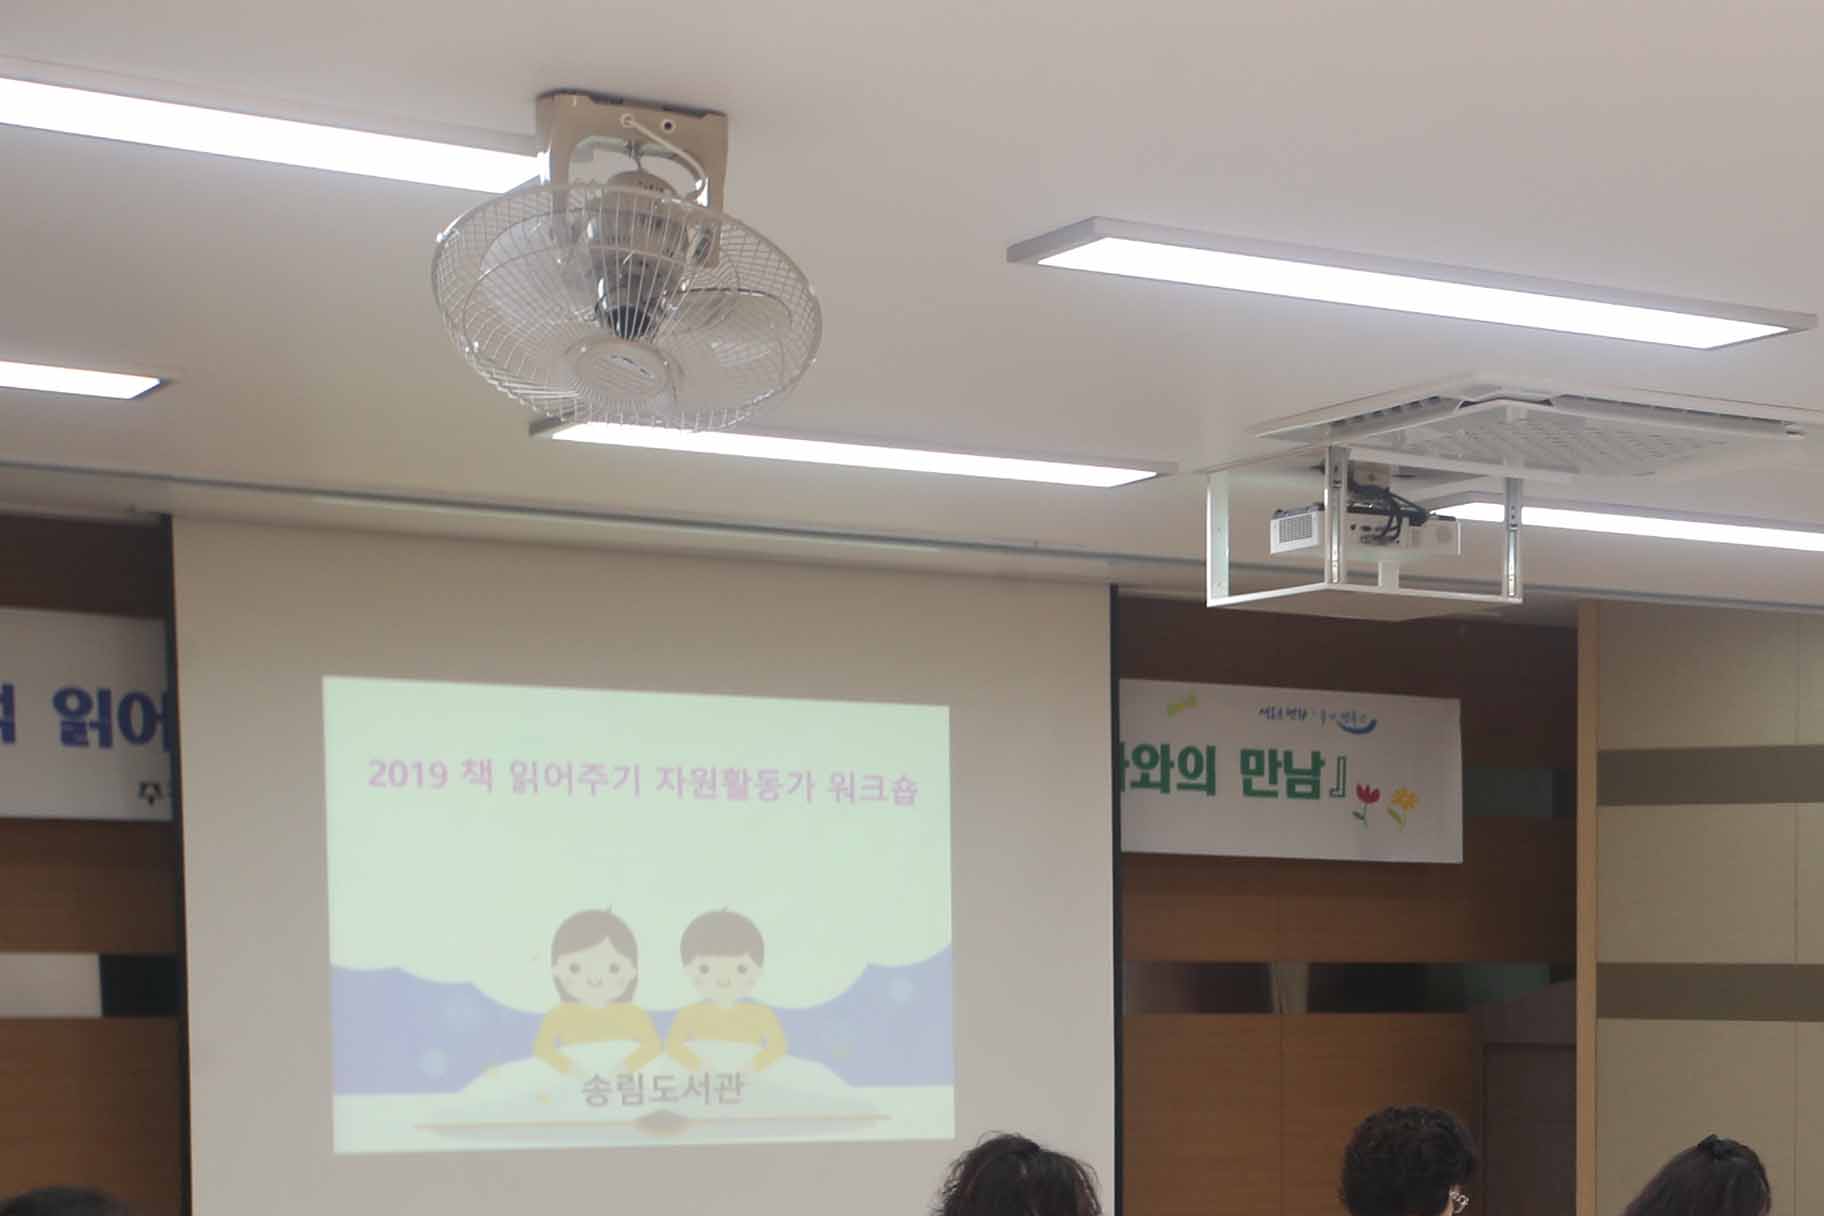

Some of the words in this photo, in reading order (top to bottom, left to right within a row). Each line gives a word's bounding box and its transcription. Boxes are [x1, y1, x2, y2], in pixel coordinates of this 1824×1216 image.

[368, 759, 449, 790] 2019
[461, 758, 493, 796] 책
[509, 760, 641, 799] 읽어주기
[655, 763, 817, 803] 자원활동가
[829, 769, 918, 807] 워크숍
[1239, 748, 1347, 800] 만남』
[582, 1072, 749, 1107] 송림도서관
